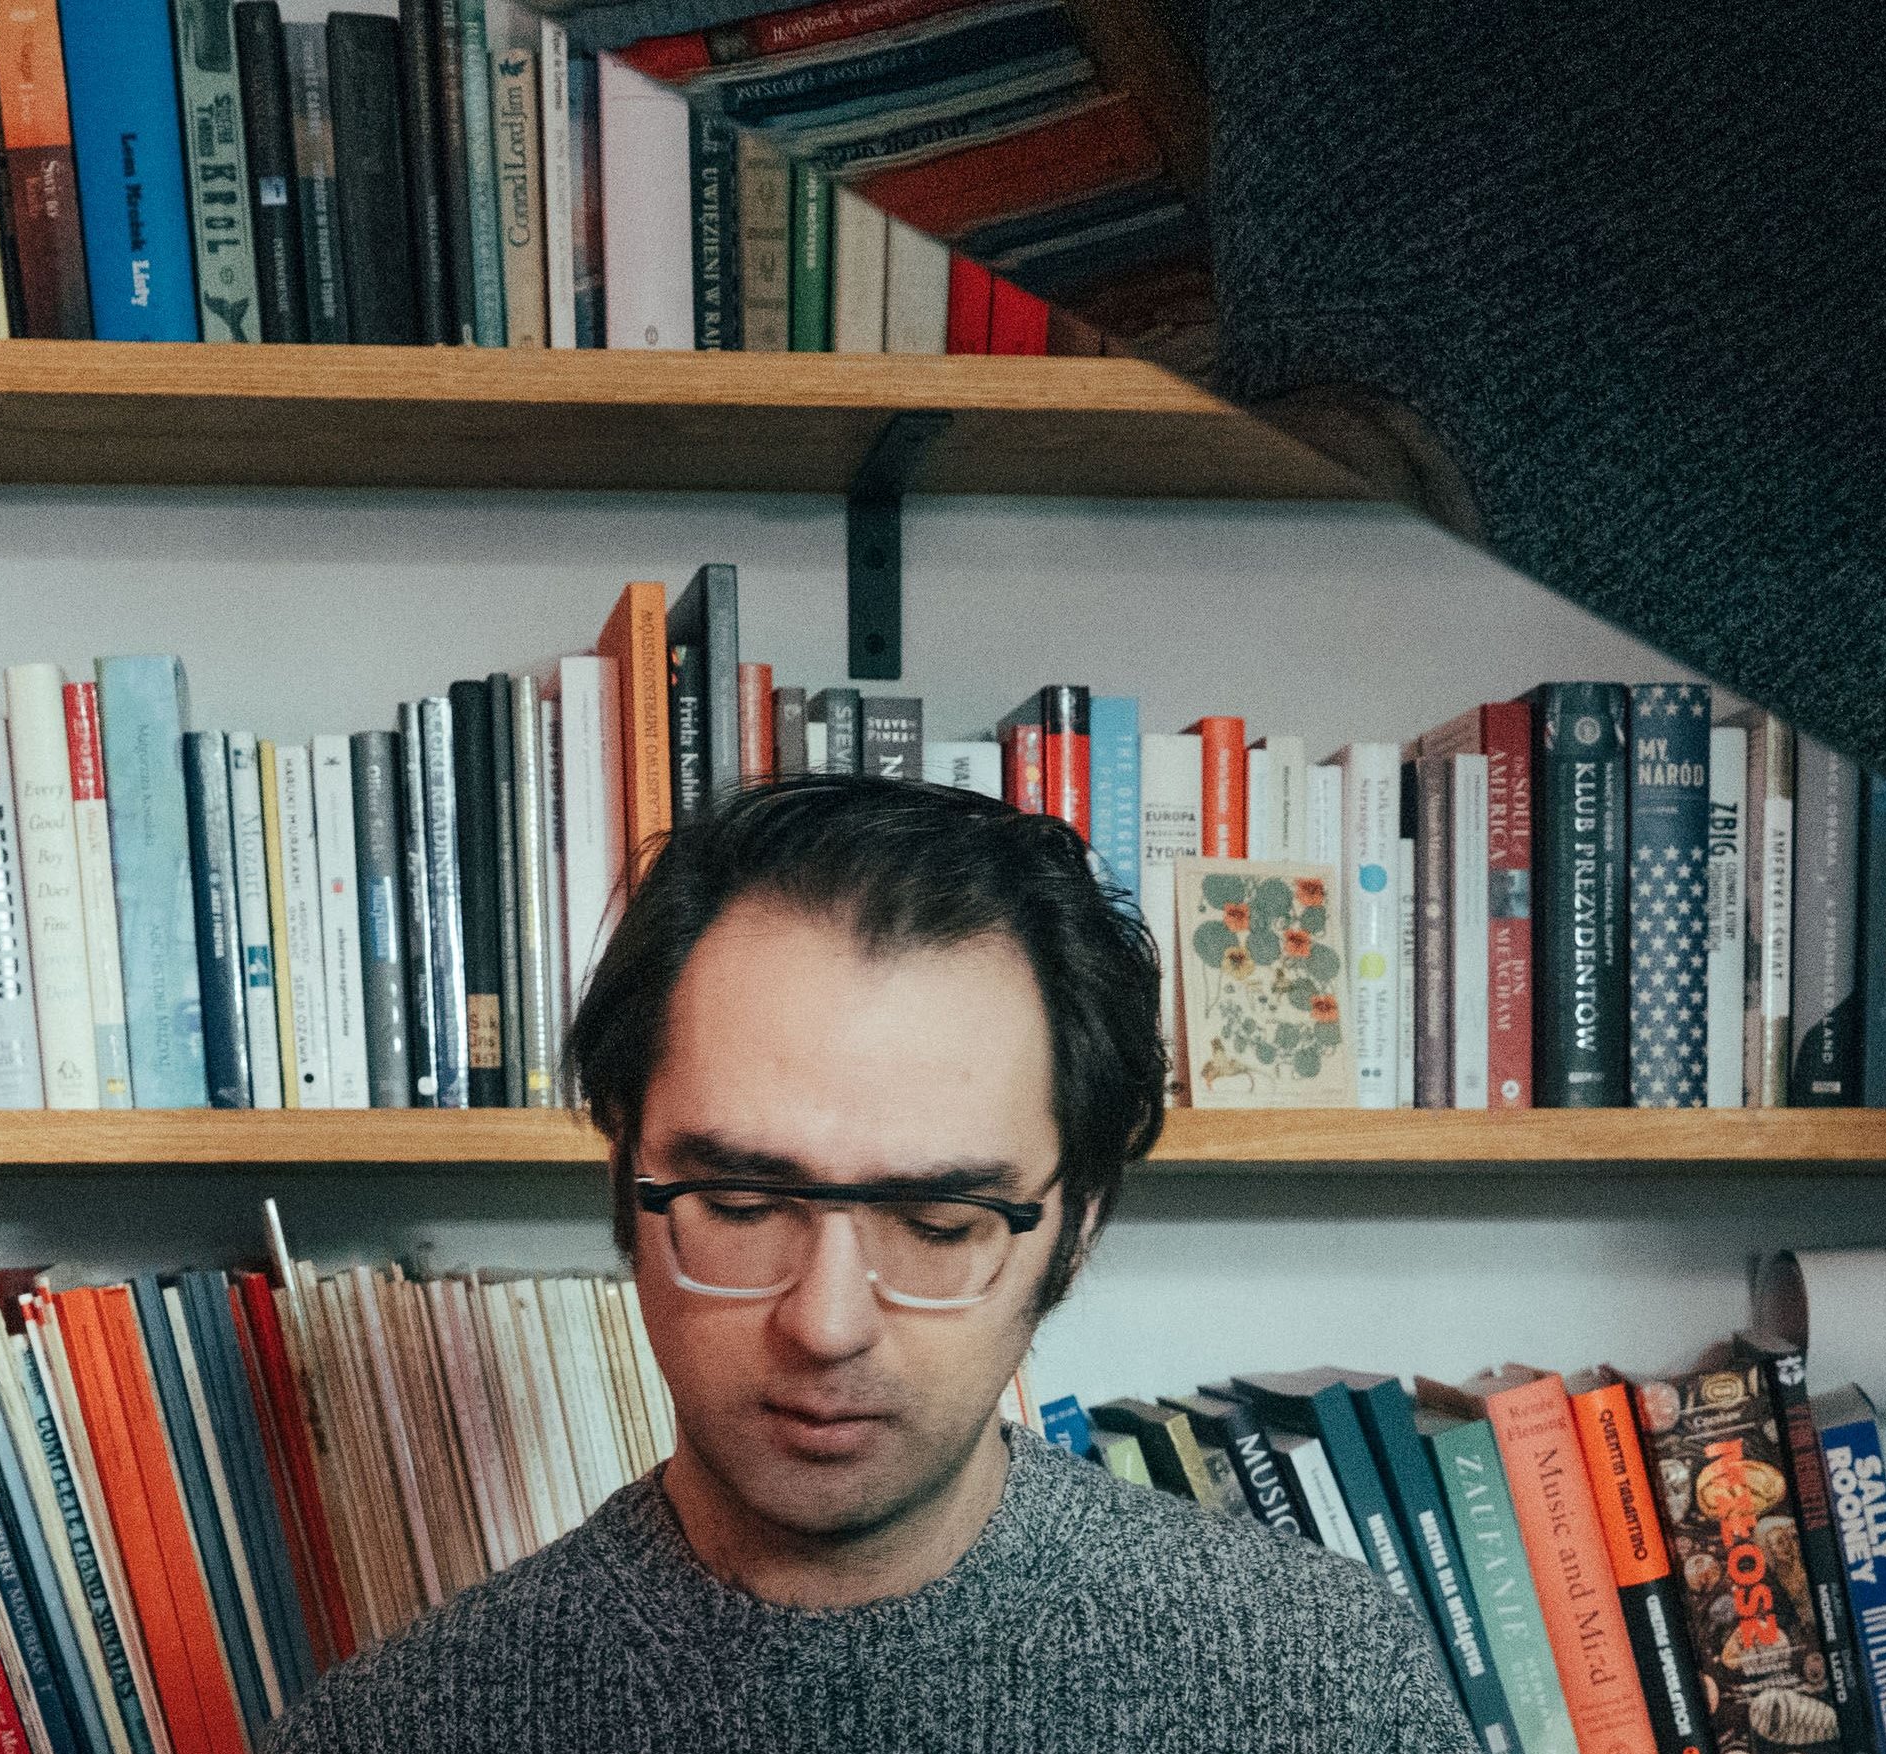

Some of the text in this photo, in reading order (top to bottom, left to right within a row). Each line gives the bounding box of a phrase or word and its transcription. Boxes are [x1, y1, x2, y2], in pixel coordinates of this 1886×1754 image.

[119, 132, 137, 176] Lem
[130, 260, 150, 307] Listy
[282, 757, 297, 811] HARUKI
[679, 695, 701, 811] Frida Kahlo
[1636, 762, 1705, 788] NARÓD
[1145, 811, 1197, 823] EUROPA
[1488, 747, 1509, 862] AMERICA
[1511, 777, 1530, 839] SOUL
[1706, 801, 1739, 857] ZBIG
[239, 811, 265, 900] Mozart
[1572, 761, 1599, 1051] KLUB PREZYDENTÓW
[1494, 926, 1512, 1031] MEACHAM
[1511, 959, 1527, 994] JON
[1598, 1407, 1649, 1562] QUENTIN TARANTINO
[1825, 1445, 1876, 1585] ROONEY
[1418, 1510, 1457, 1597] MUZYKA DLA
[1454, 1454, 1529, 1643] ZAUFANIE
[1532, 1447, 1618, 1688] Music and Mind
[1817, 1582, 1838, 1643] MOORE
[1828, 1651, 1848, 1704] LLOYD
